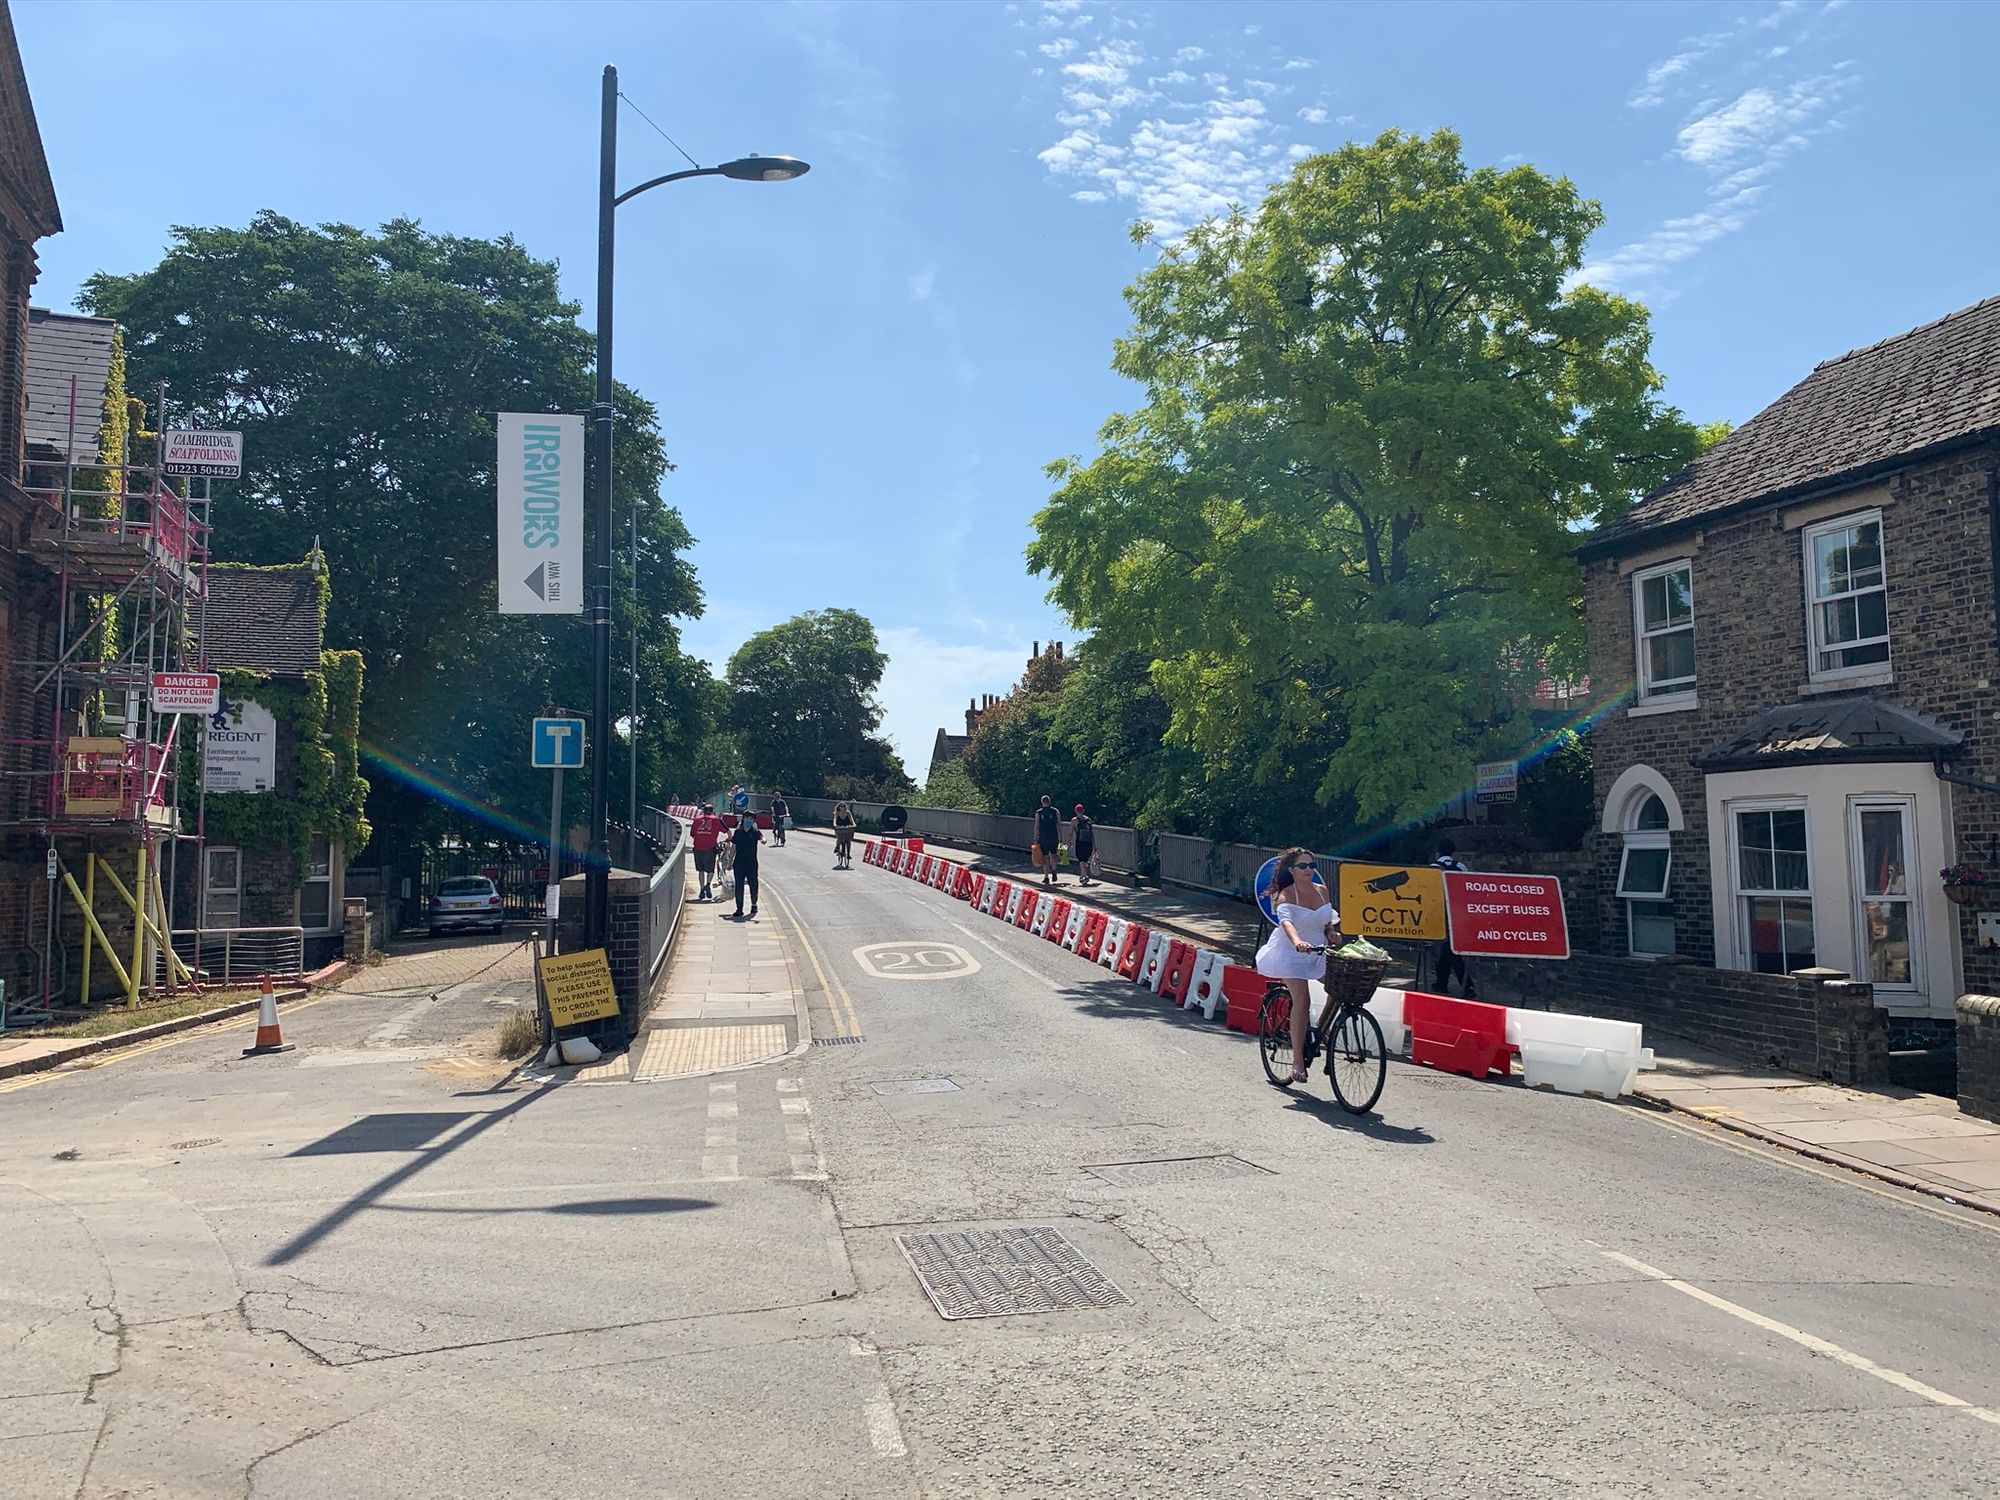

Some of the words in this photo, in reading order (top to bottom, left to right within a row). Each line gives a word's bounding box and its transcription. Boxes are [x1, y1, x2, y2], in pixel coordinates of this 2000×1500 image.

[173, 433, 234, 447] CAMBRIDGE
[168, 447, 237, 461] SCAFFOLDING
[167, 464, 197, 474] 01223
[199, 465, 237, 476] 504422
[523, 424, 561, 549] IRONWORKS
[549, 560, 561, 580] WAY
[549, 582, 561, 602] THIS
[164, 677, 209, 687] DANGER
[171, 688, 188, 696] NOT
[190, 688, 214, 696] CLIMB
[158, 696, 213, 704] SCAFFOLDING
[208, 731, 264, 743] REGENT
[1465, 881, 1498, 893] ROAD
[1499, 883, 1545, 895] CLOSED
[1362, 906, 1424, 926] CCTV
[1467, 903, 1511, 915] EXCEPT
[1513, 905, 1551, 916] BUSES
[1362, 923, 1372, 933] in
[1375, 925, 1424, 936] operation
[1477, 929, 1501, 941] AND
[1502, 931, 1548, 942] CYCLES
[546, 966, 556, 974] To
[557, 964, 573, 973] help
[574, 958, 602, 970] support
[874, 950, 962, 969] 20
[546, 974, 569, 983] social
[569, 966, 607, 978] distancing
[557, 984, 585, 994] PLEASE
[586, 979, 602, 988] USE
[553, 995, 571, 1004] THIS
[572, 987, 610, 1001] PAVEMENT
[569, 1000, 595, 1011] CROSS
[596, 997, 611, 1006] THE
[573, 1008, 601, 1020] BRIDGE
